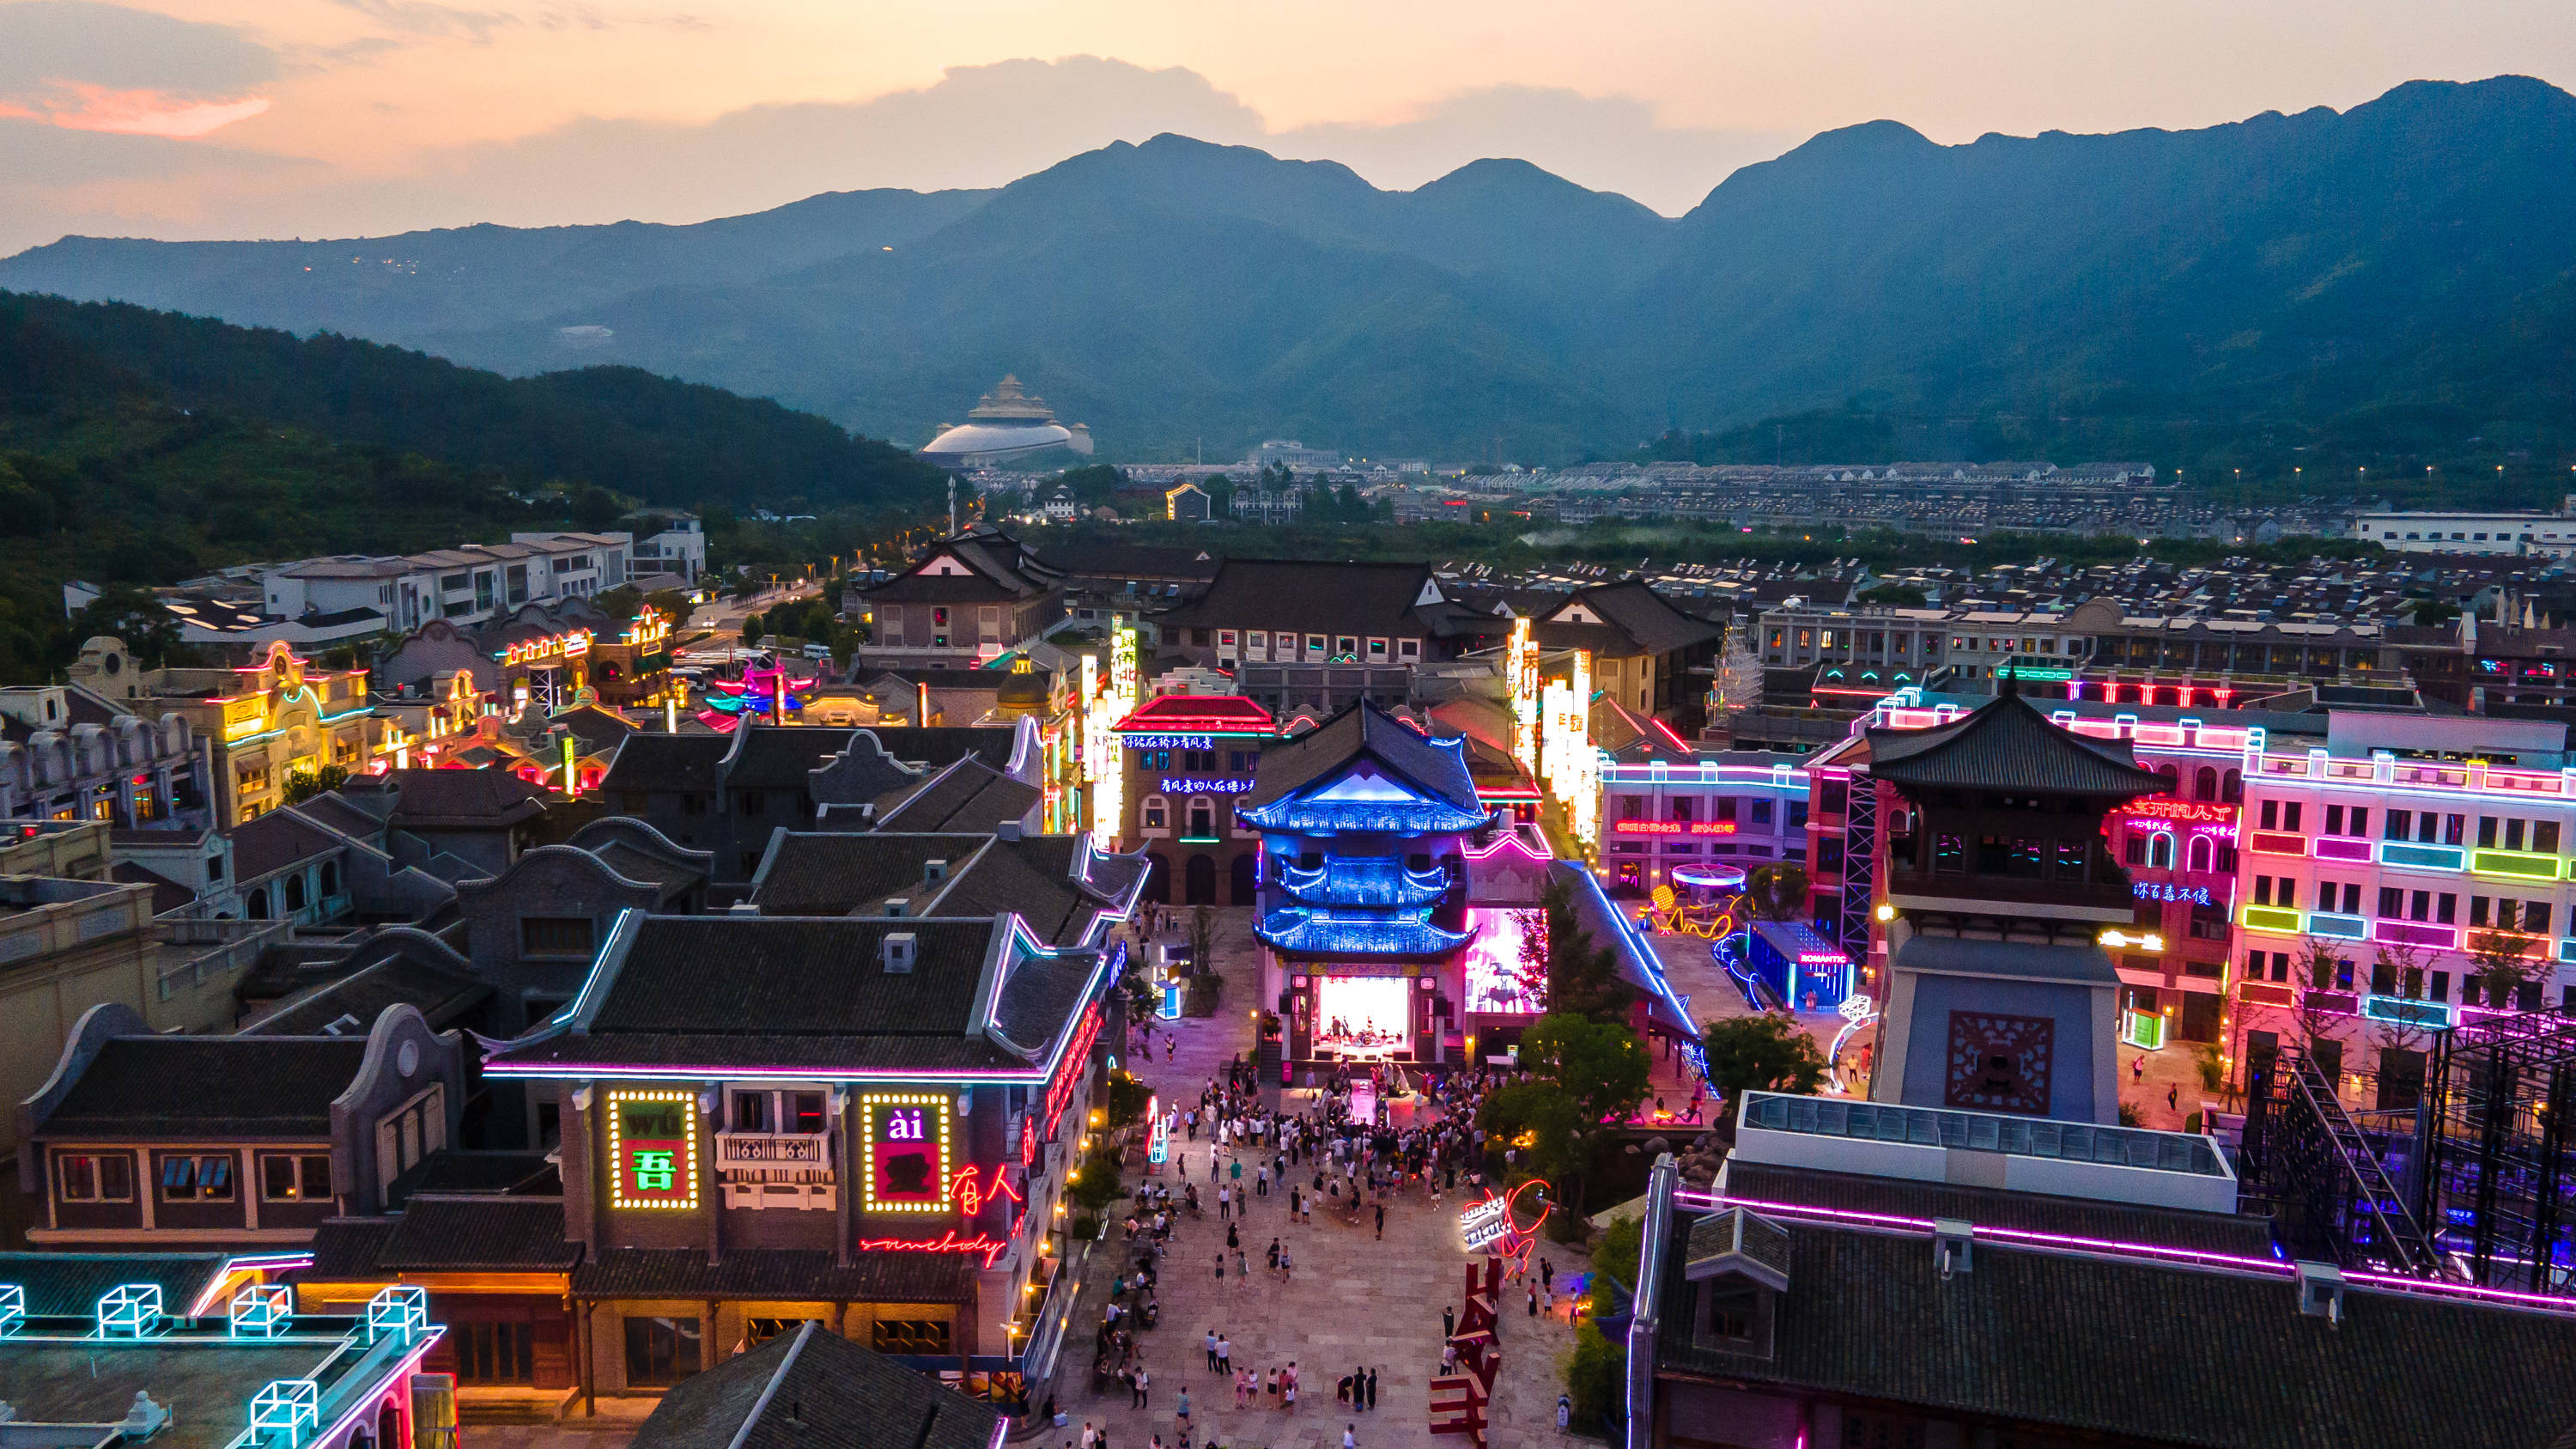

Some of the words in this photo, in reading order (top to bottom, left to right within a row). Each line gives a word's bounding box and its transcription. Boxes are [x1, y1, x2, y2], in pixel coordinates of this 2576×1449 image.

[1800, 954, 1847, 964] ROMANTIC
[888, 1110, 925, 1140] ài
[630, 1149, 677, 1191] 吾
[951, 1164, 1022, 1216] 有人
[860, 1230, 1008, 1269] somebody
